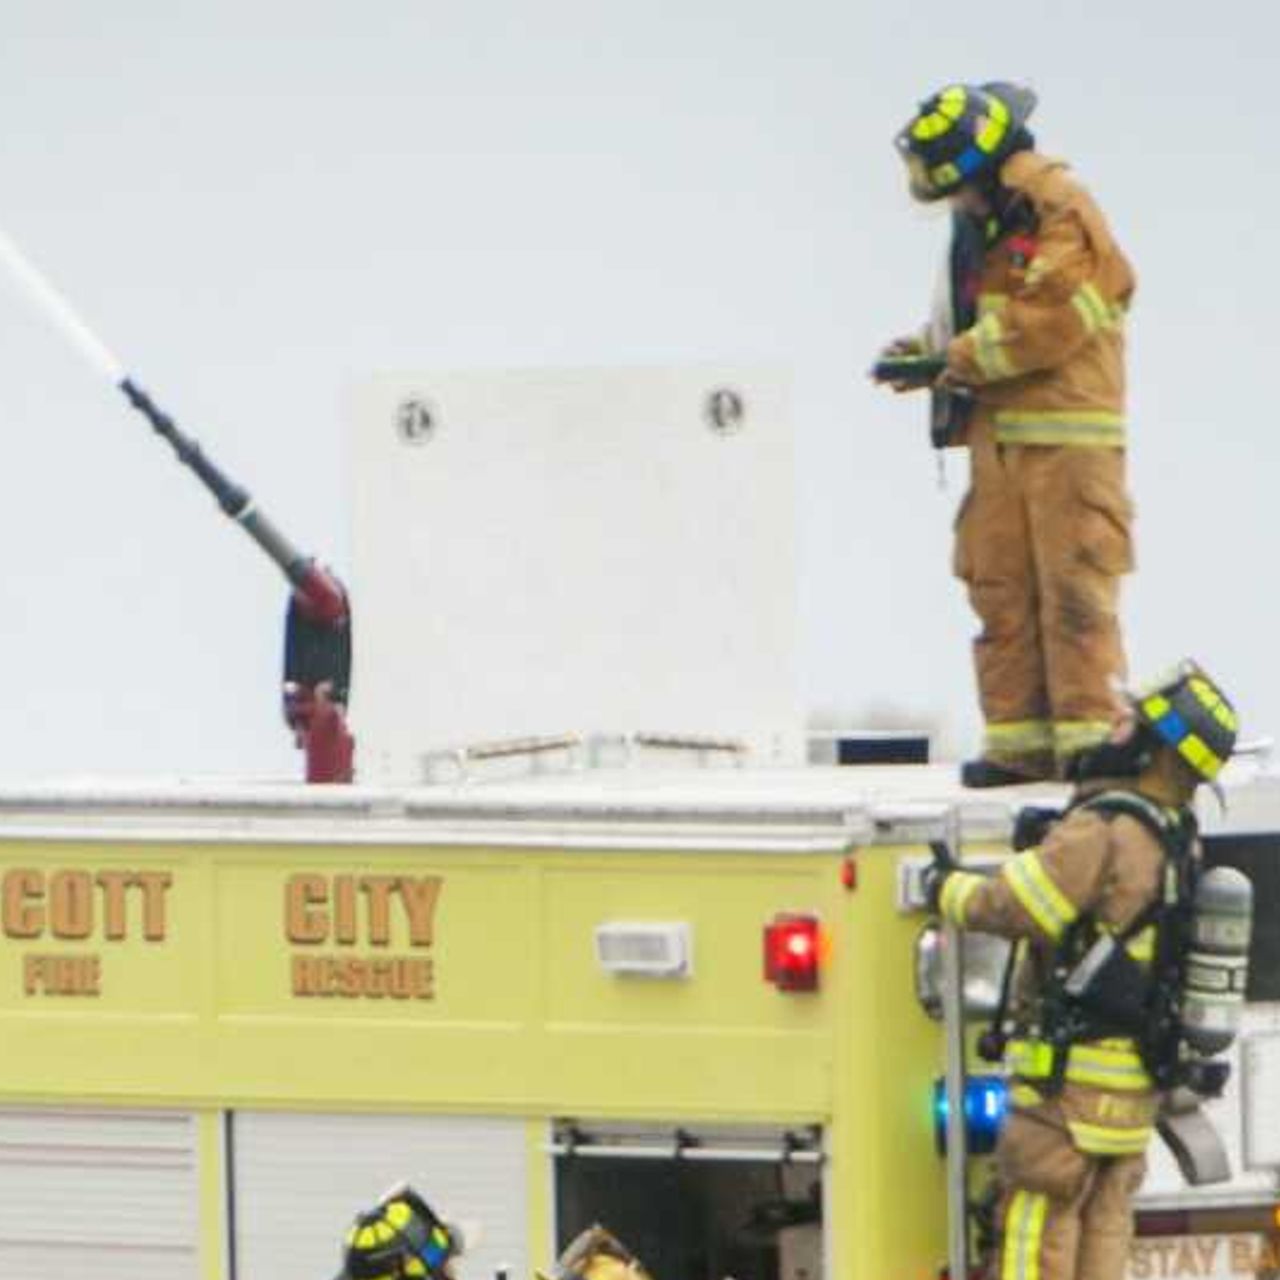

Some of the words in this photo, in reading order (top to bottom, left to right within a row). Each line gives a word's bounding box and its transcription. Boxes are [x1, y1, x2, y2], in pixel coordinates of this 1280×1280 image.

[285, 873, 445, 946] CITY
[23, 954, 100, 996] FIRE
[292, 955, 434, 1000] RESCUE
[1130, 1234, 1217, 1279] STAY
